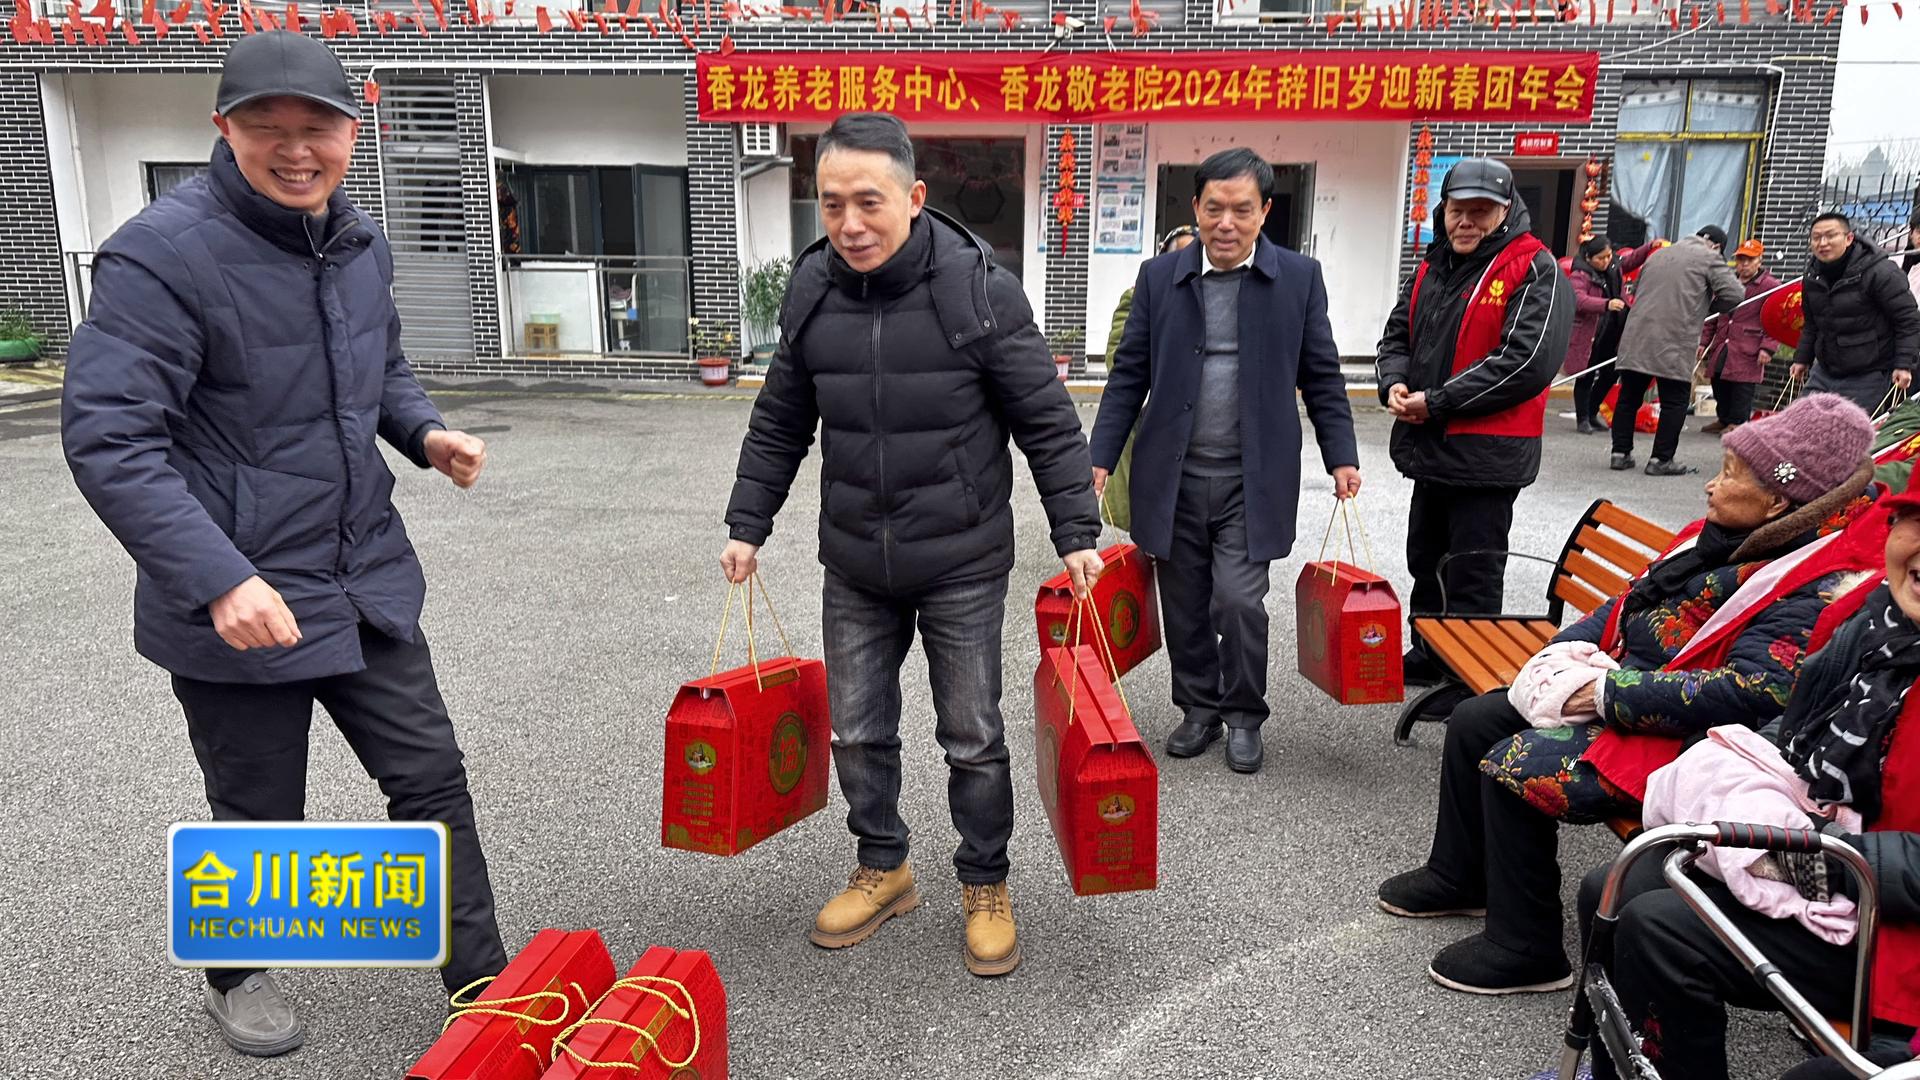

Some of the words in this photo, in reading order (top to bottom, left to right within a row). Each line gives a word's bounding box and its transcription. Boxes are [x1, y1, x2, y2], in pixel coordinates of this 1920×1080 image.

[707, 63, 1586, 112] 香龙养老服务中心、香龙敬老院2024年辞旧岁迎新春团年会
